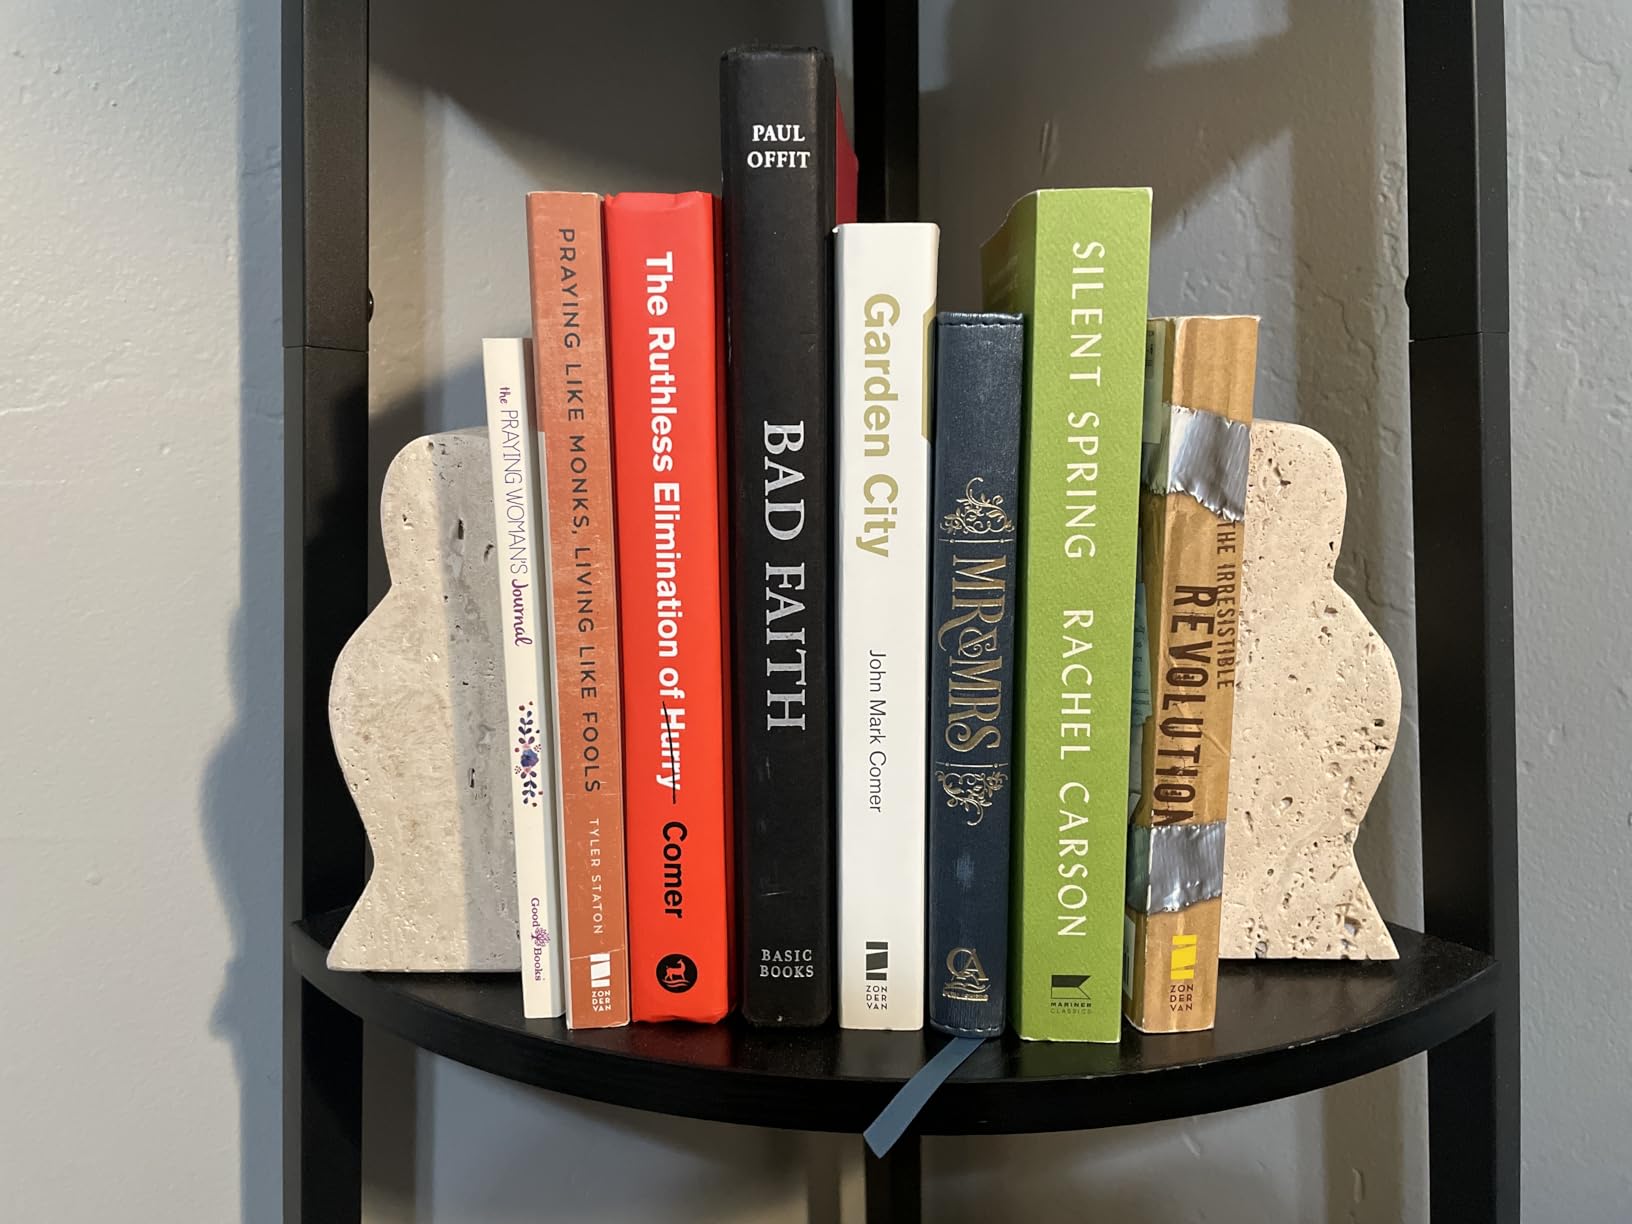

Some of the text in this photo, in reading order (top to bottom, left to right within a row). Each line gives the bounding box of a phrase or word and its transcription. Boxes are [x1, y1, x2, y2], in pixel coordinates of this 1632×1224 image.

[746, 151, 811, 169] OFFIT
[751, 124, 806, 142] PAUL
[855, 293, 901, 558] Garden City
[1064, 241, 1105, 558] SILENT SPRING
[499, 386, 534, 647] the PRAYING WOMAN'S Journal
[558, 228, 601, 793] PRAYING LIKE MONKS, LIVING LIKE FOOLS
[645, 251, 687, 791] The Ruthless Elimination of Hurry
[763, 420, 808, 731] BAD FAITH
[1216, 521, 1236, 690] THE IRRESISTIBLE
[938, 554, 1007, 753] MR & MRS
[869, 649, 887, 813] John Mark Comer
[1057, 609, 1094, 936] RACHEL CARSON
[589, 818, 604, 934] TYLER STATON
[662, 821, 688, 919] Comer
[530, 897, 543, 982] Good Books
[759, 965, 815, 979] BOOKS
[760, 949, 813, 962] BASIC
[592, 990, 611, 998] ZON
[866, 985, 888, 993] ZON
[866, 994, 888, 1002] DER
[866, 1002, 888, 1010] VAN
[1170, 984, 1194, 993] ZON
[1170, 994, 1193, 1003] DER
[1170, 1003, 1193, 1012] VAN
